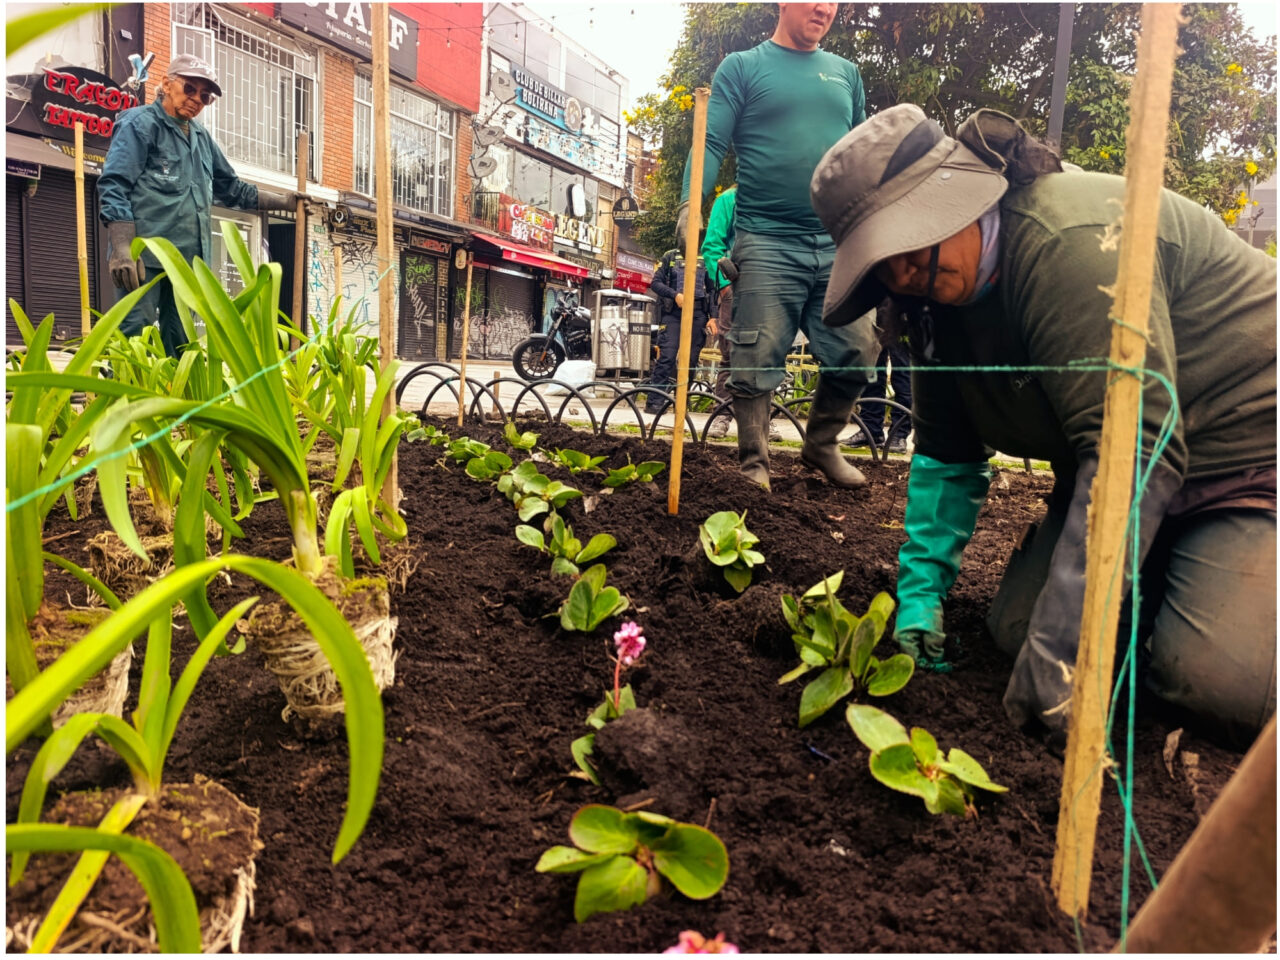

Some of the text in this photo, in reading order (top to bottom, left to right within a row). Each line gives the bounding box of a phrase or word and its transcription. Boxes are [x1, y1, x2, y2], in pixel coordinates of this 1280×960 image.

[516, 70, 566, 108] CLUB DE BILLAR
[522, 88, 557, 119] BOLIRANA
